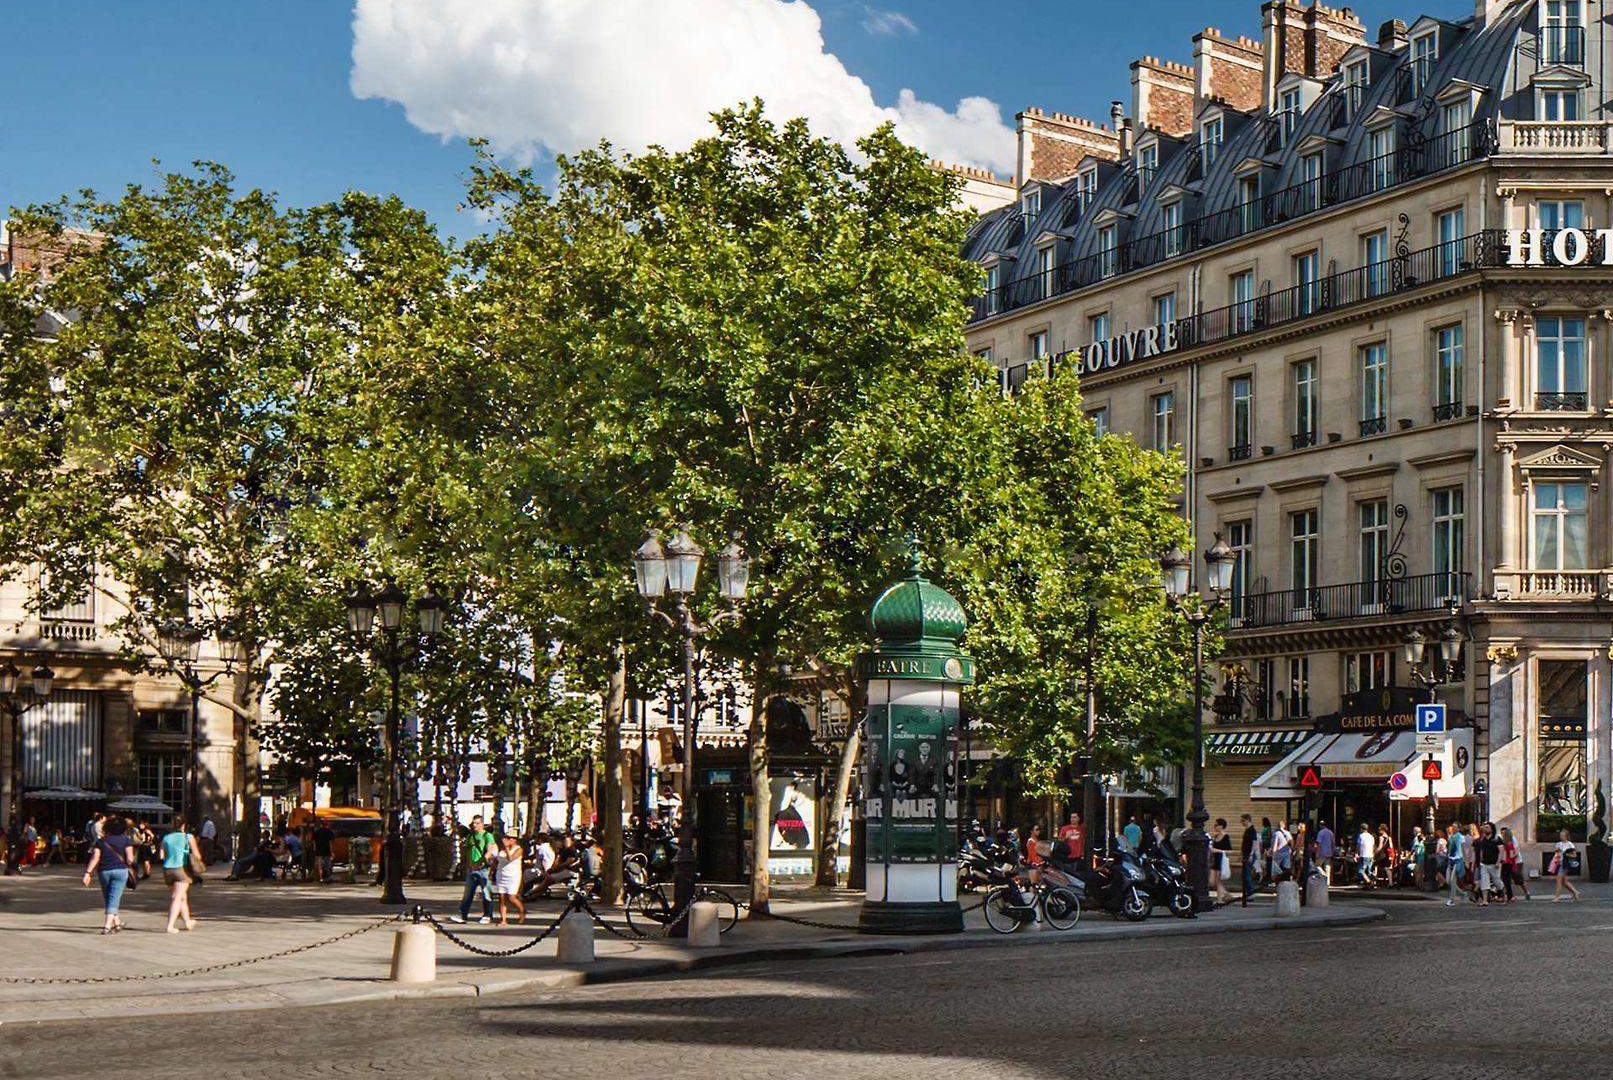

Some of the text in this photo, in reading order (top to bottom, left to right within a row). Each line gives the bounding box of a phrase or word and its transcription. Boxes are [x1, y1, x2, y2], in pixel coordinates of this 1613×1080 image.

[1364, 715, 1376, 728] DE
[1378, 715, 1393, 727] LA
[1393, 713, 1415, 726] COM
[1424, 710, 1437, 728] P
[816, 722, 849, 739] BRASS
[1216, 746, 1227, 754] LA
[892, 798, 937, 818] MUR
